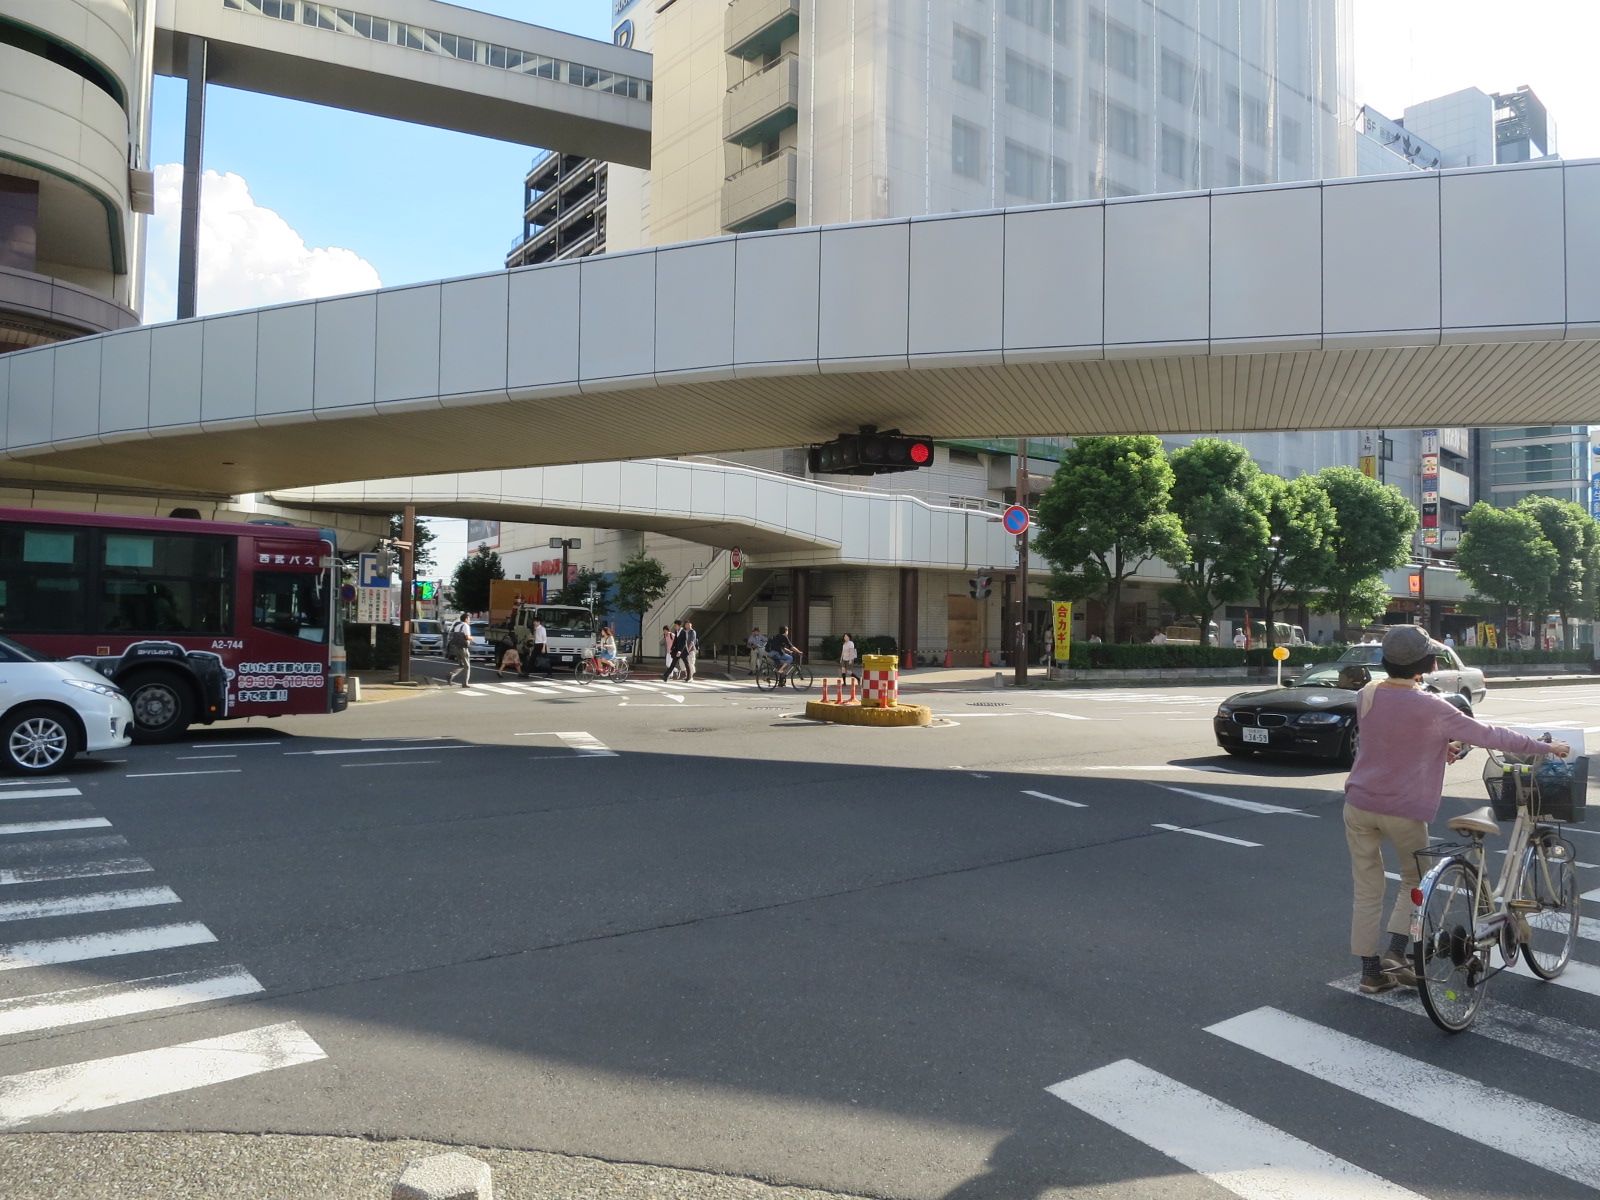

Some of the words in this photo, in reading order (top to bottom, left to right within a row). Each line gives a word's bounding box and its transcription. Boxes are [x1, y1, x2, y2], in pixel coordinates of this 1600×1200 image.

[259, 553, 314, 566] 西武バス
[1057, 605, 1068, 644] 合カギ
[211, 640, 243, 649] A2-744
[239, 662, 322, 673] さいたま新都心駅前
